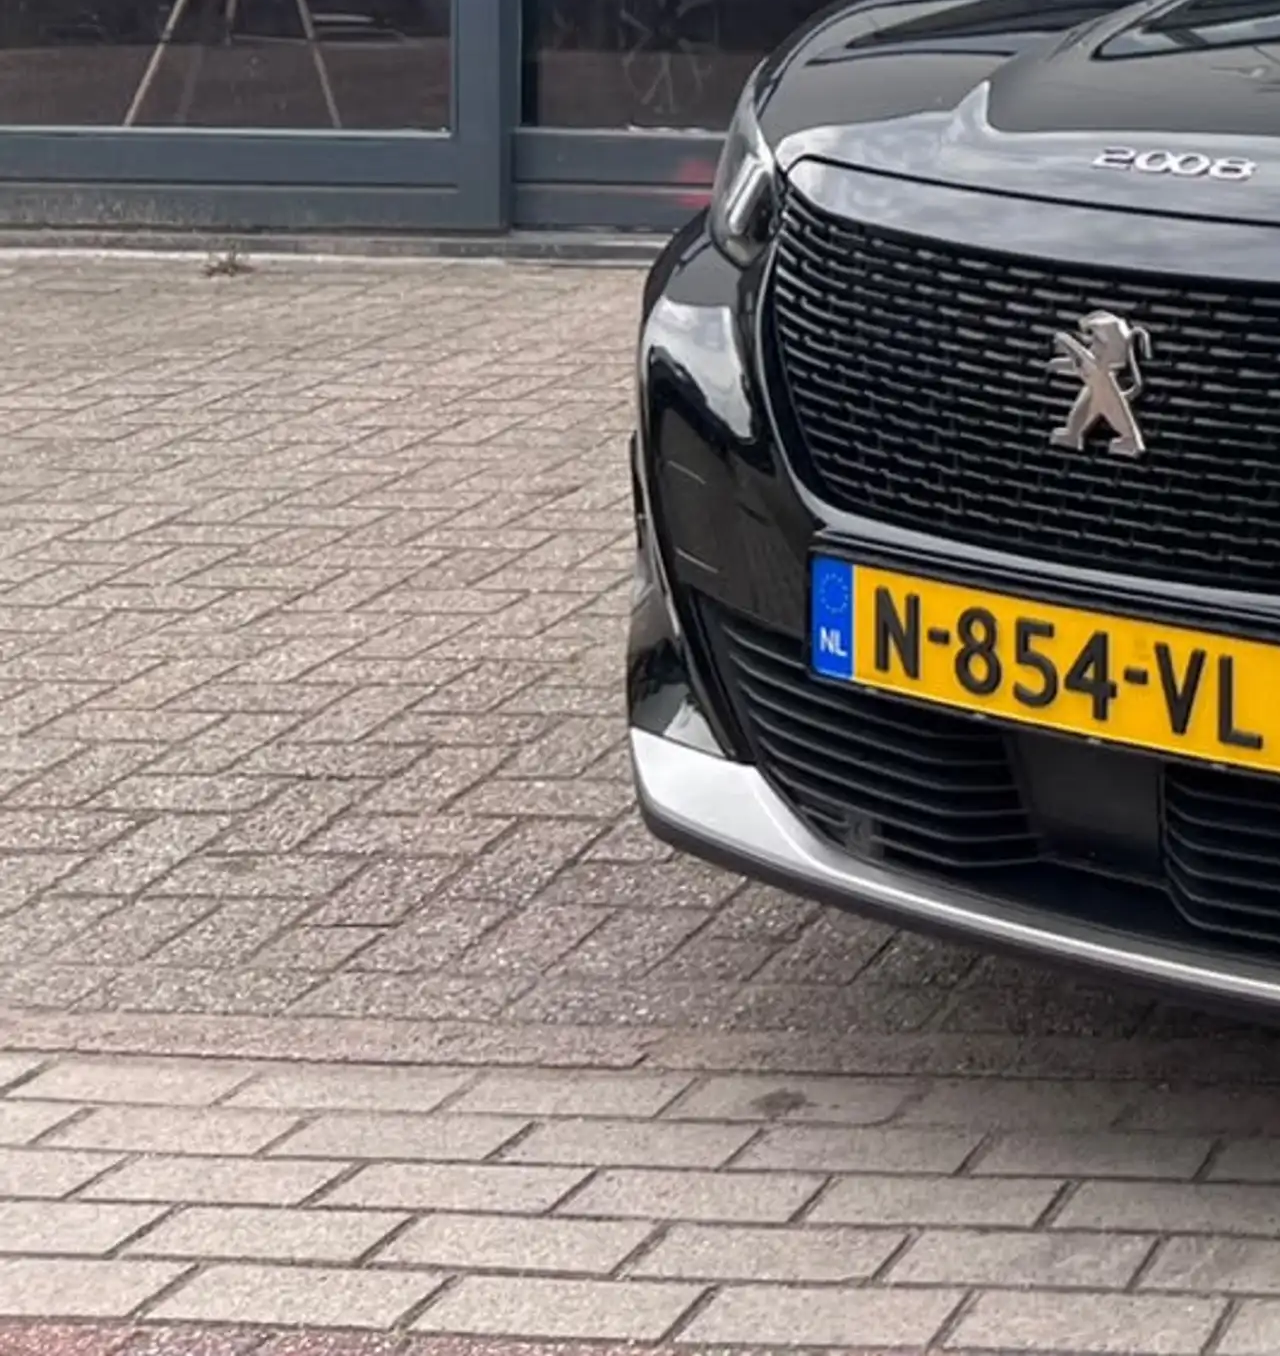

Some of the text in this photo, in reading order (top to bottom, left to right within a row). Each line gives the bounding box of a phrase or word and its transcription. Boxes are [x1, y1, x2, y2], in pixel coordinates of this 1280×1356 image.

[1091, 146, 1257, 181] 2008
[819, 627, 848, 657] NL
[873, 585, 1264, 751] N-854-VL
